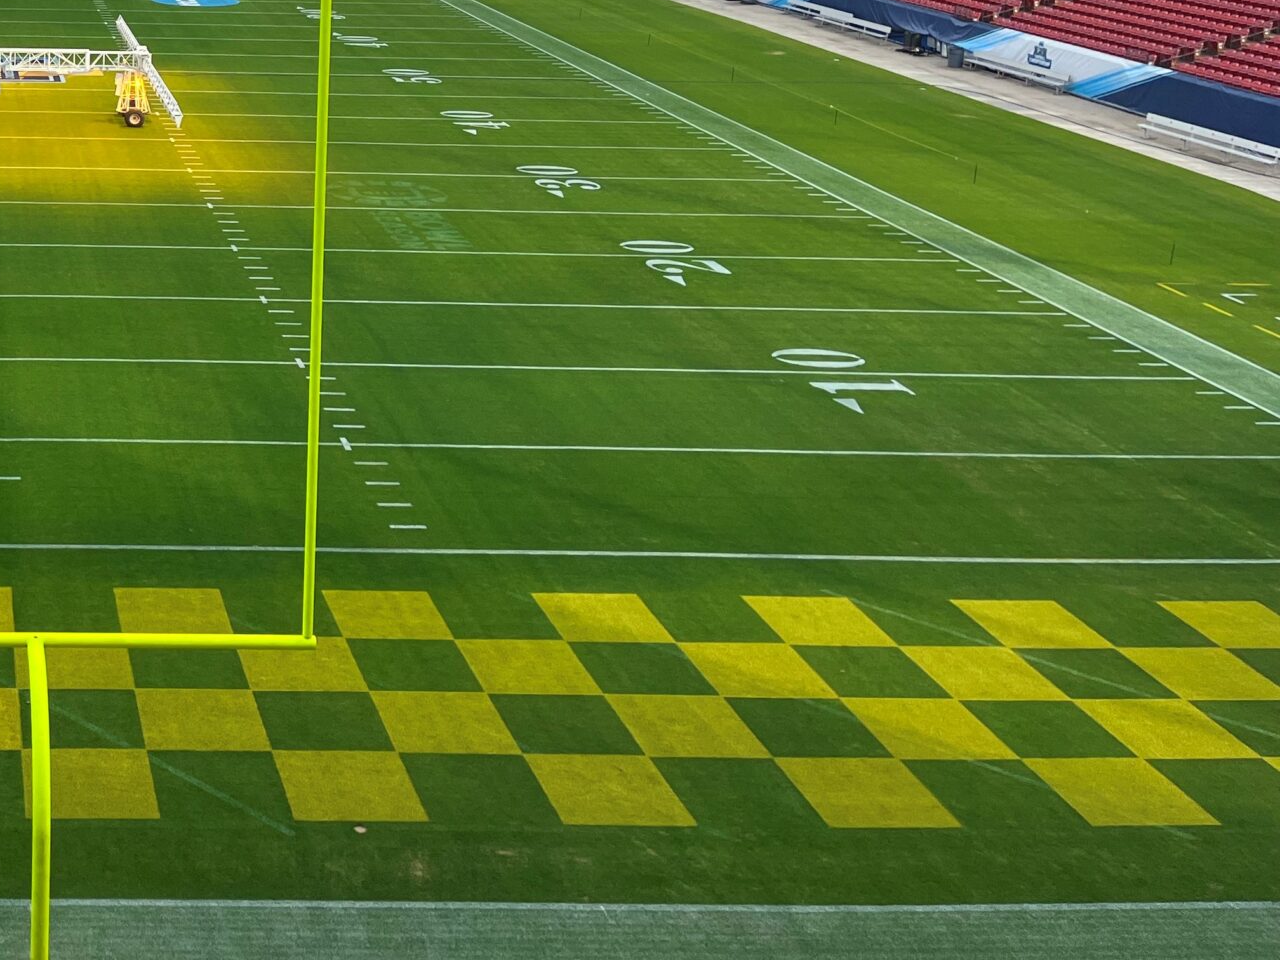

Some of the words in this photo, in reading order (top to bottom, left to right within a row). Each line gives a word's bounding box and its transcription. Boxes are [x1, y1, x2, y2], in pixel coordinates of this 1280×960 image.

[382, 68, 443, 85] 50
[440, 110, 511, 130] 40
[516, 165, 602, 190] 30
[620, 240, 732, 276] 20
[771, 348, 917, 395] 10
